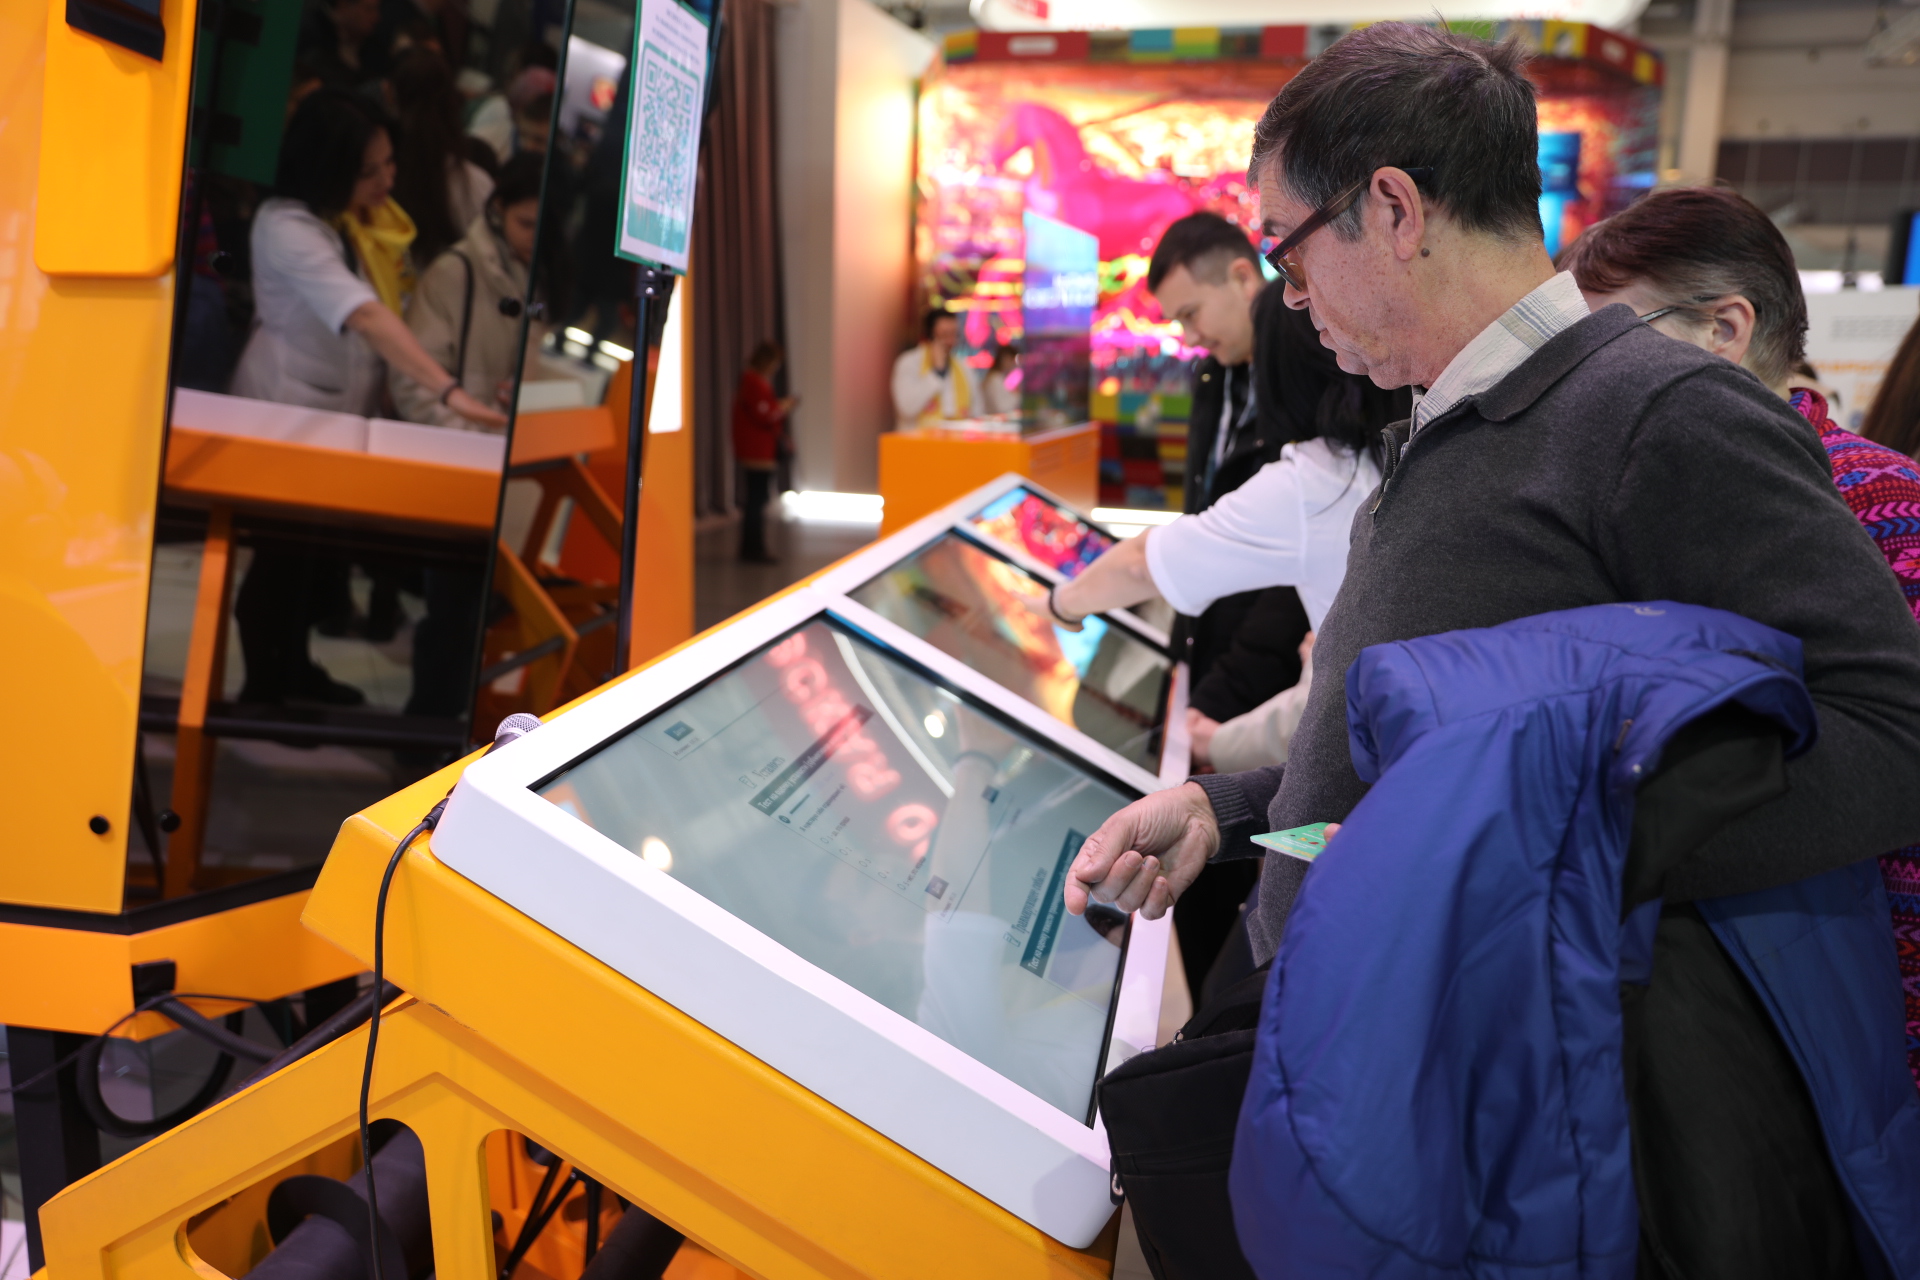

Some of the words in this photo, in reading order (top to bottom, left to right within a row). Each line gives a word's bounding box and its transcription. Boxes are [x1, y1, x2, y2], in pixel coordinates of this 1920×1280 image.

[751, 756, 786, 780] Усталость
[757, 797, 772, 809] Тест
[1027, 956, 1041, 970] Тест
